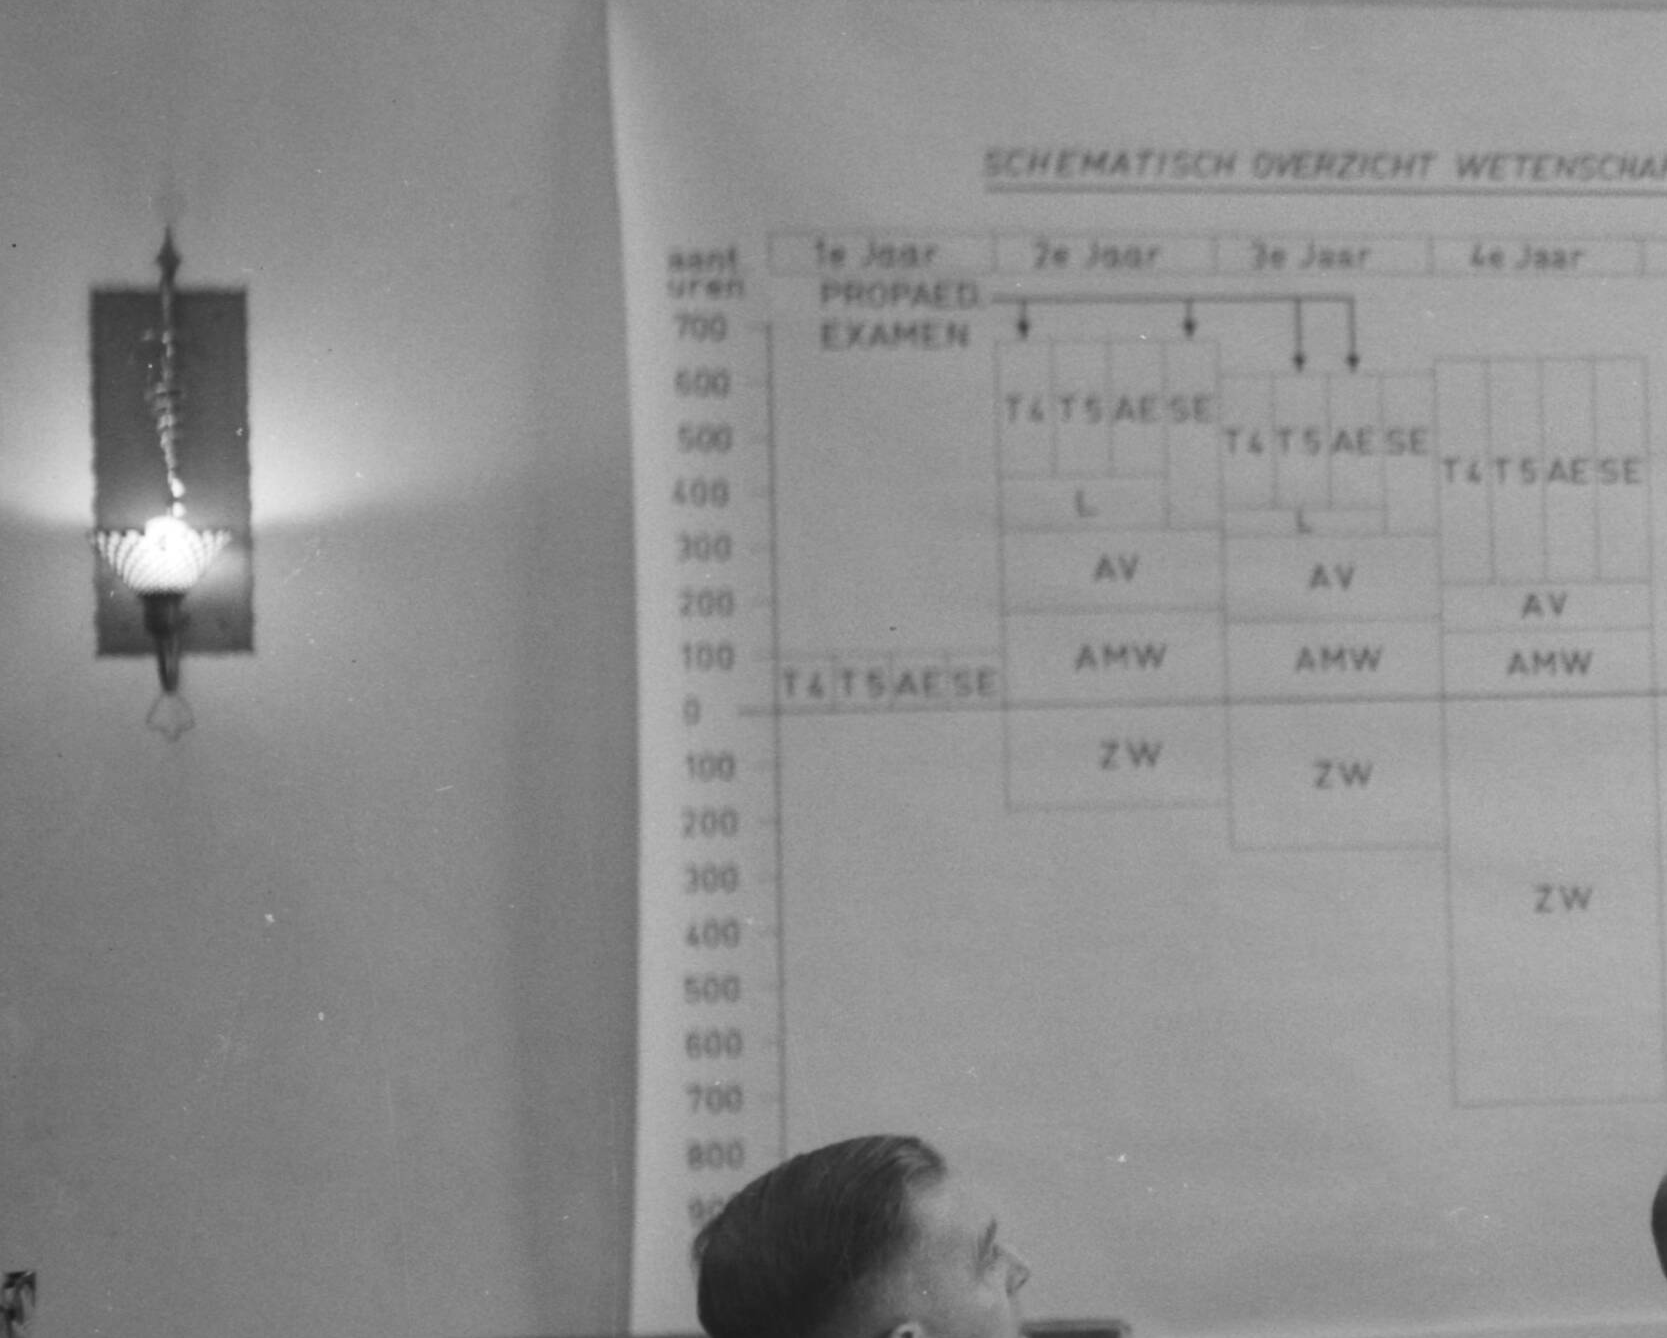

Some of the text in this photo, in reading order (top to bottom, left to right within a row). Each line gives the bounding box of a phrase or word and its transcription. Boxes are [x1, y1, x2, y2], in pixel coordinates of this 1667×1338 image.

[984, 149, 1236, 179] SCHEMATISCH
[1252, 150, 1438, 182] OVERZICHT
[674, 312, 729, 344] 700
[820, 322, 972, 351] EXAMEN
[676, 424, 733, 454] 500
[671, 478, 730, 507] 400
[1093, 554, 1140, 584] AV
[1307, 564, 1357, 593] AV
[679, 589, 735, 618] 200
[1520, 593, 1569, 619] AV
[681, 644, 736, 671] 100
[1074, 643, 1169, 671] AMW
[1293, 645, 1384, 673] AMW
[1506, 649, 1594, 677] AMW
[685, 752, 737, 781] 100
[682, 808, 739, 837] 200
[684, 919, 741, 948] 400
[684, 975, 741, 1004] 500
[687, 1084, 744, 1113] 700
